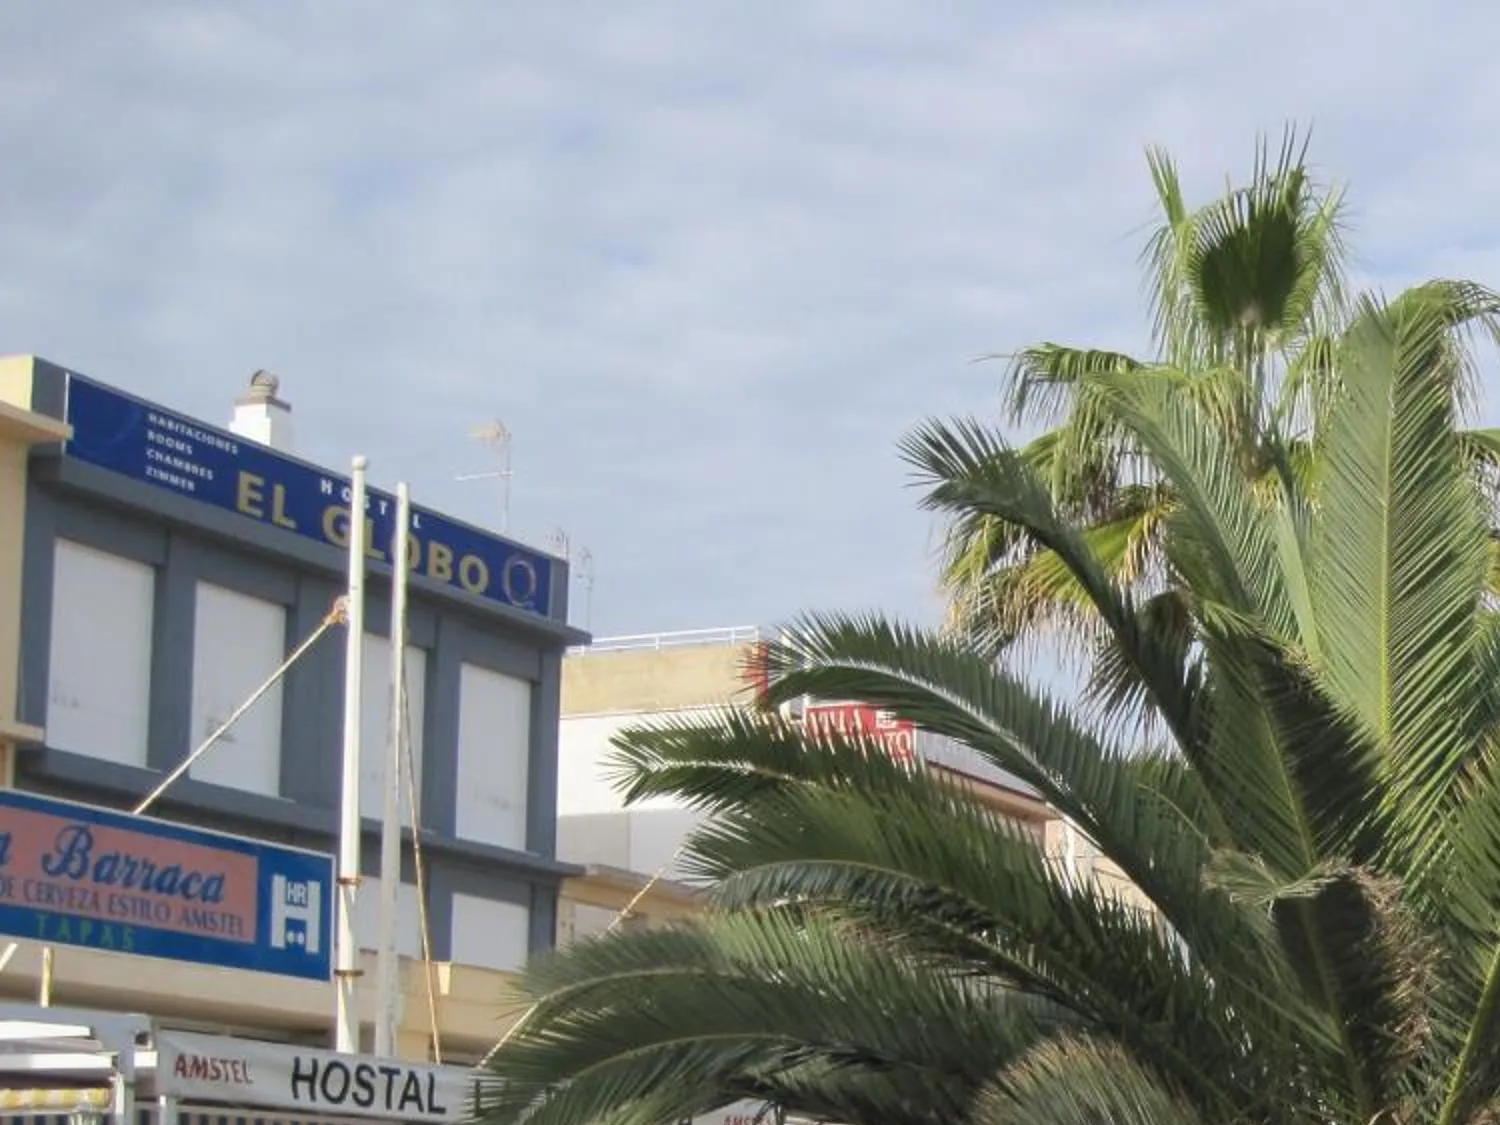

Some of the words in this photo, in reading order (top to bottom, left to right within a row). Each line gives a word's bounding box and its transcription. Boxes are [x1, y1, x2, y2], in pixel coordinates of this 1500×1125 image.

[147, 430, 193, 456] ROOMS
[148, 413, 238, 456] HABITACIONES
[145, 465, 195, 492] ZIMMER
[146, 448, 214, 481] CHAMBRES
[320, 478, 421, 529] HOSTL
[236, 469, 297, 530] EL
[321, 503, 490, 595] GLOBO
[41, 824, 225, 905] Barraca
[22, 878, 100, 913] CERVEZA
[179, 904, 244, 936] AMSTEL
[36, 913, 136, 950] TAPAS
[173, 1052, 253, 1085] AMSTEL
[290, 1056, 447, 1115] HOSTAL
